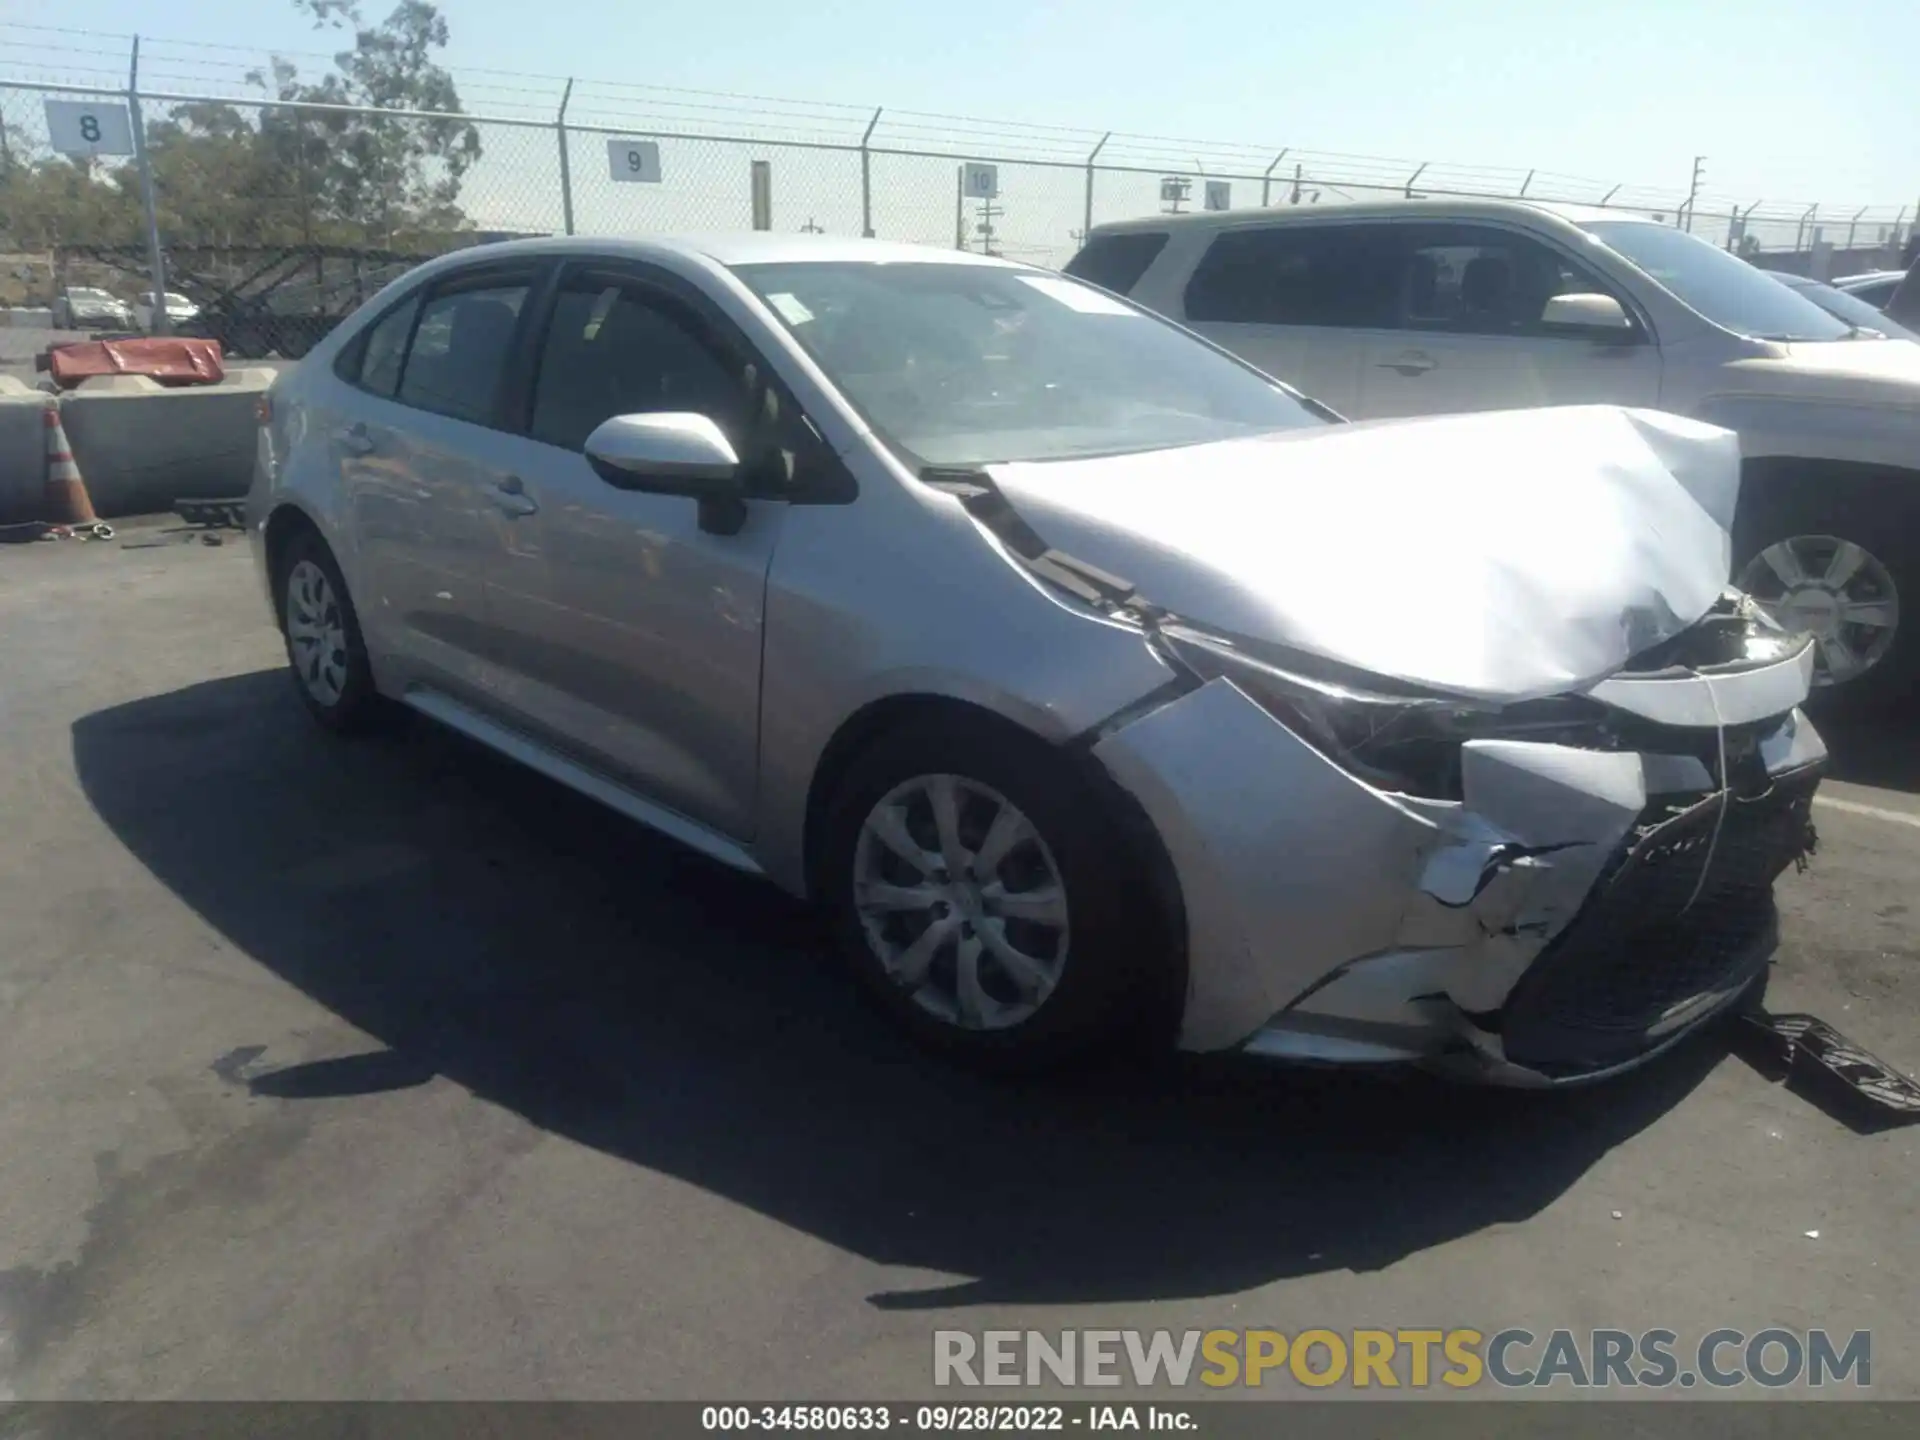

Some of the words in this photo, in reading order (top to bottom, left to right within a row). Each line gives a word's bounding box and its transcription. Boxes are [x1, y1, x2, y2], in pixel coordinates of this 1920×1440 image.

[80, 115, 101, 142] 8
[628, 151, 641, 172] 9
[973, 172, 991, 190] 10
